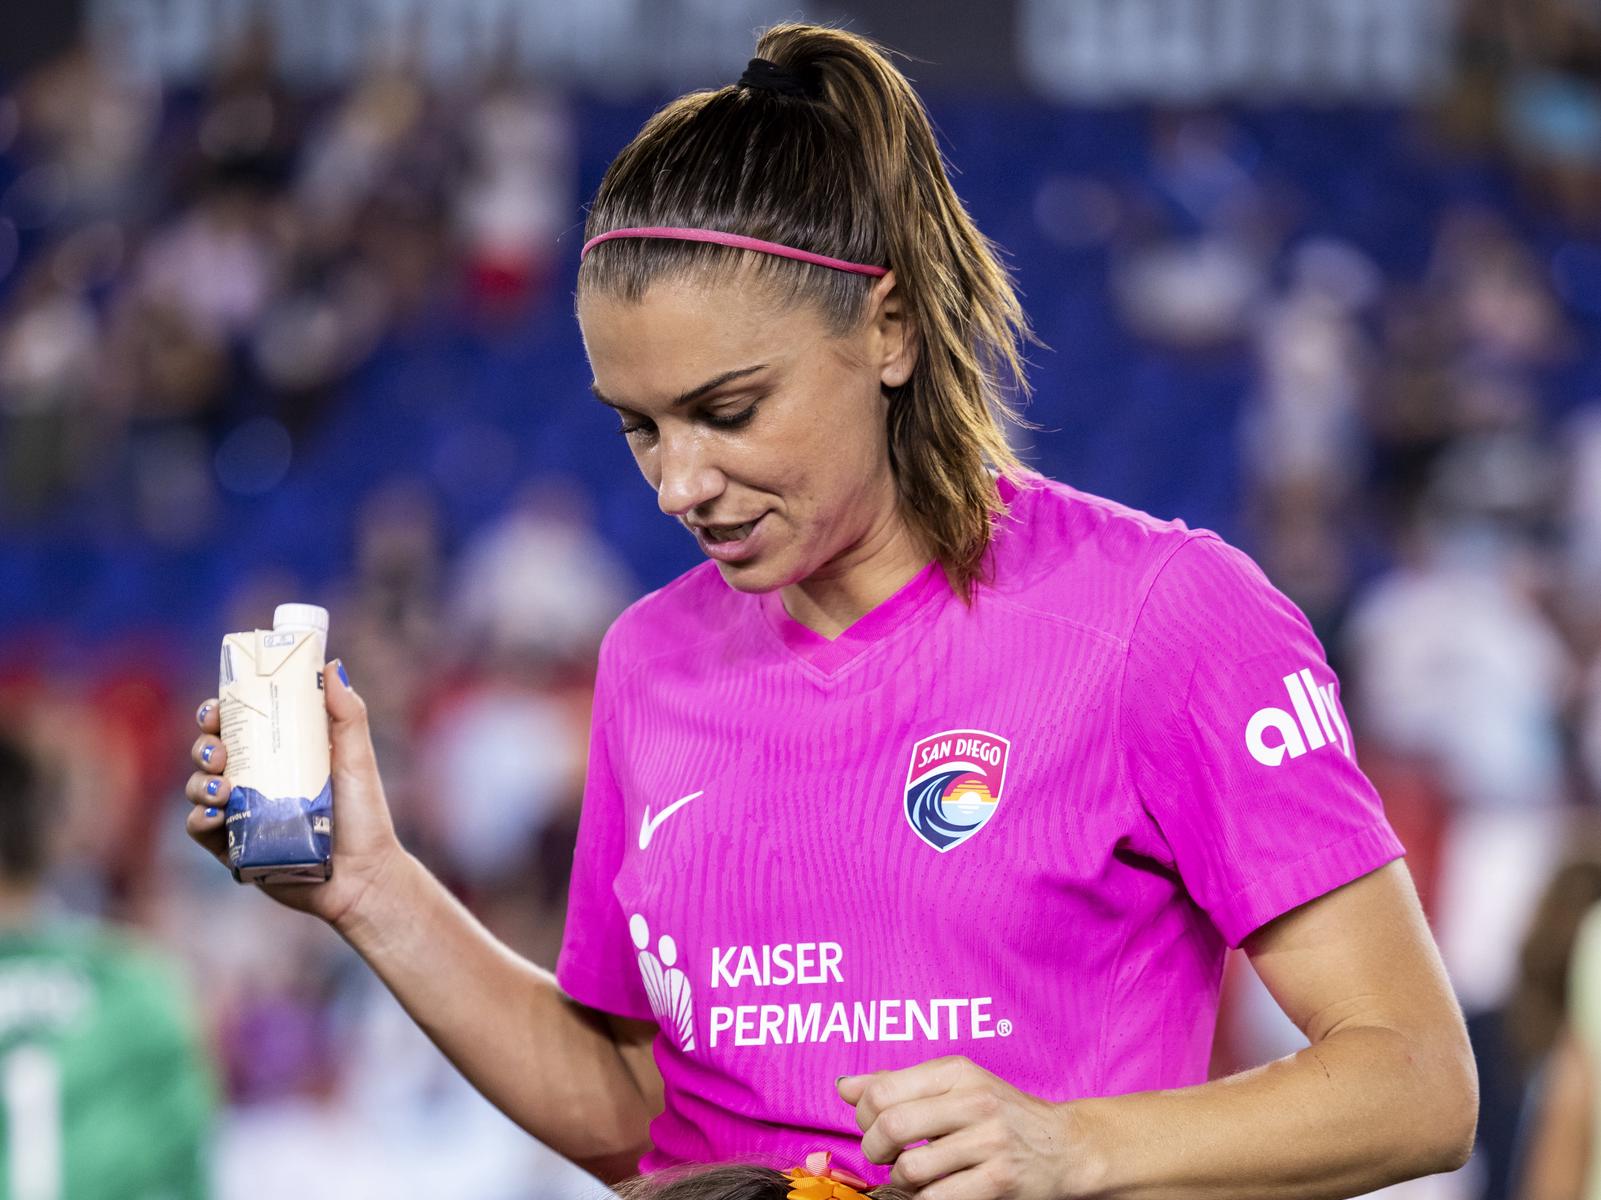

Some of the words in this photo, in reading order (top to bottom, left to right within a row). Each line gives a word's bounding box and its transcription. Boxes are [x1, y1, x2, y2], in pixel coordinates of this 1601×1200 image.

[1244, 668, 1352, 767] ally
[917, 740, 952, 768] SAN
[954, 739, 1002, 766] DIEGO
[710, 942, 845, 989] KAISER
